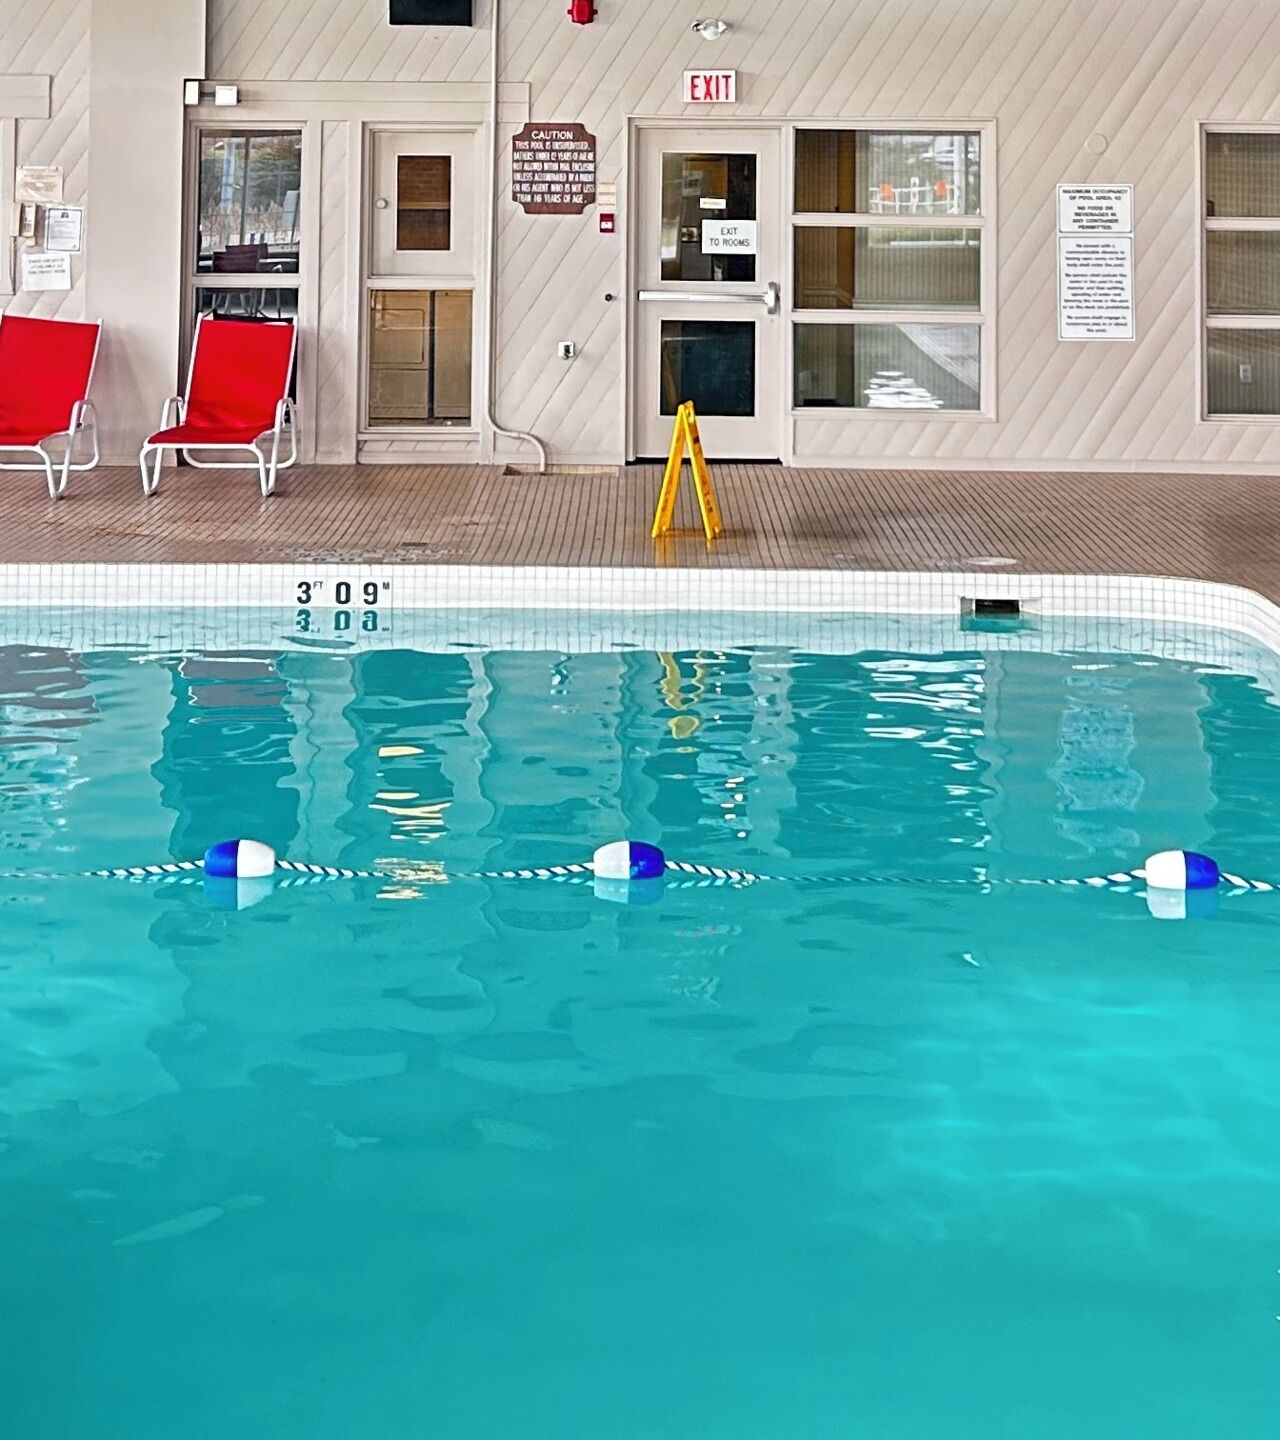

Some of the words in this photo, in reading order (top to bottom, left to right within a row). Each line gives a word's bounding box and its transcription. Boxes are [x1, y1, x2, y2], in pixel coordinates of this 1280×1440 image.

[691, 75, 731, 100] EXIT
[531, 131, 573, 139] CAUTION
[515, 141, 528, 150] THIS
[720, 227, 738, 235] EXIT
[710, 238, 720, 246] TO
[723, 238, 750, 247] ROOMS
